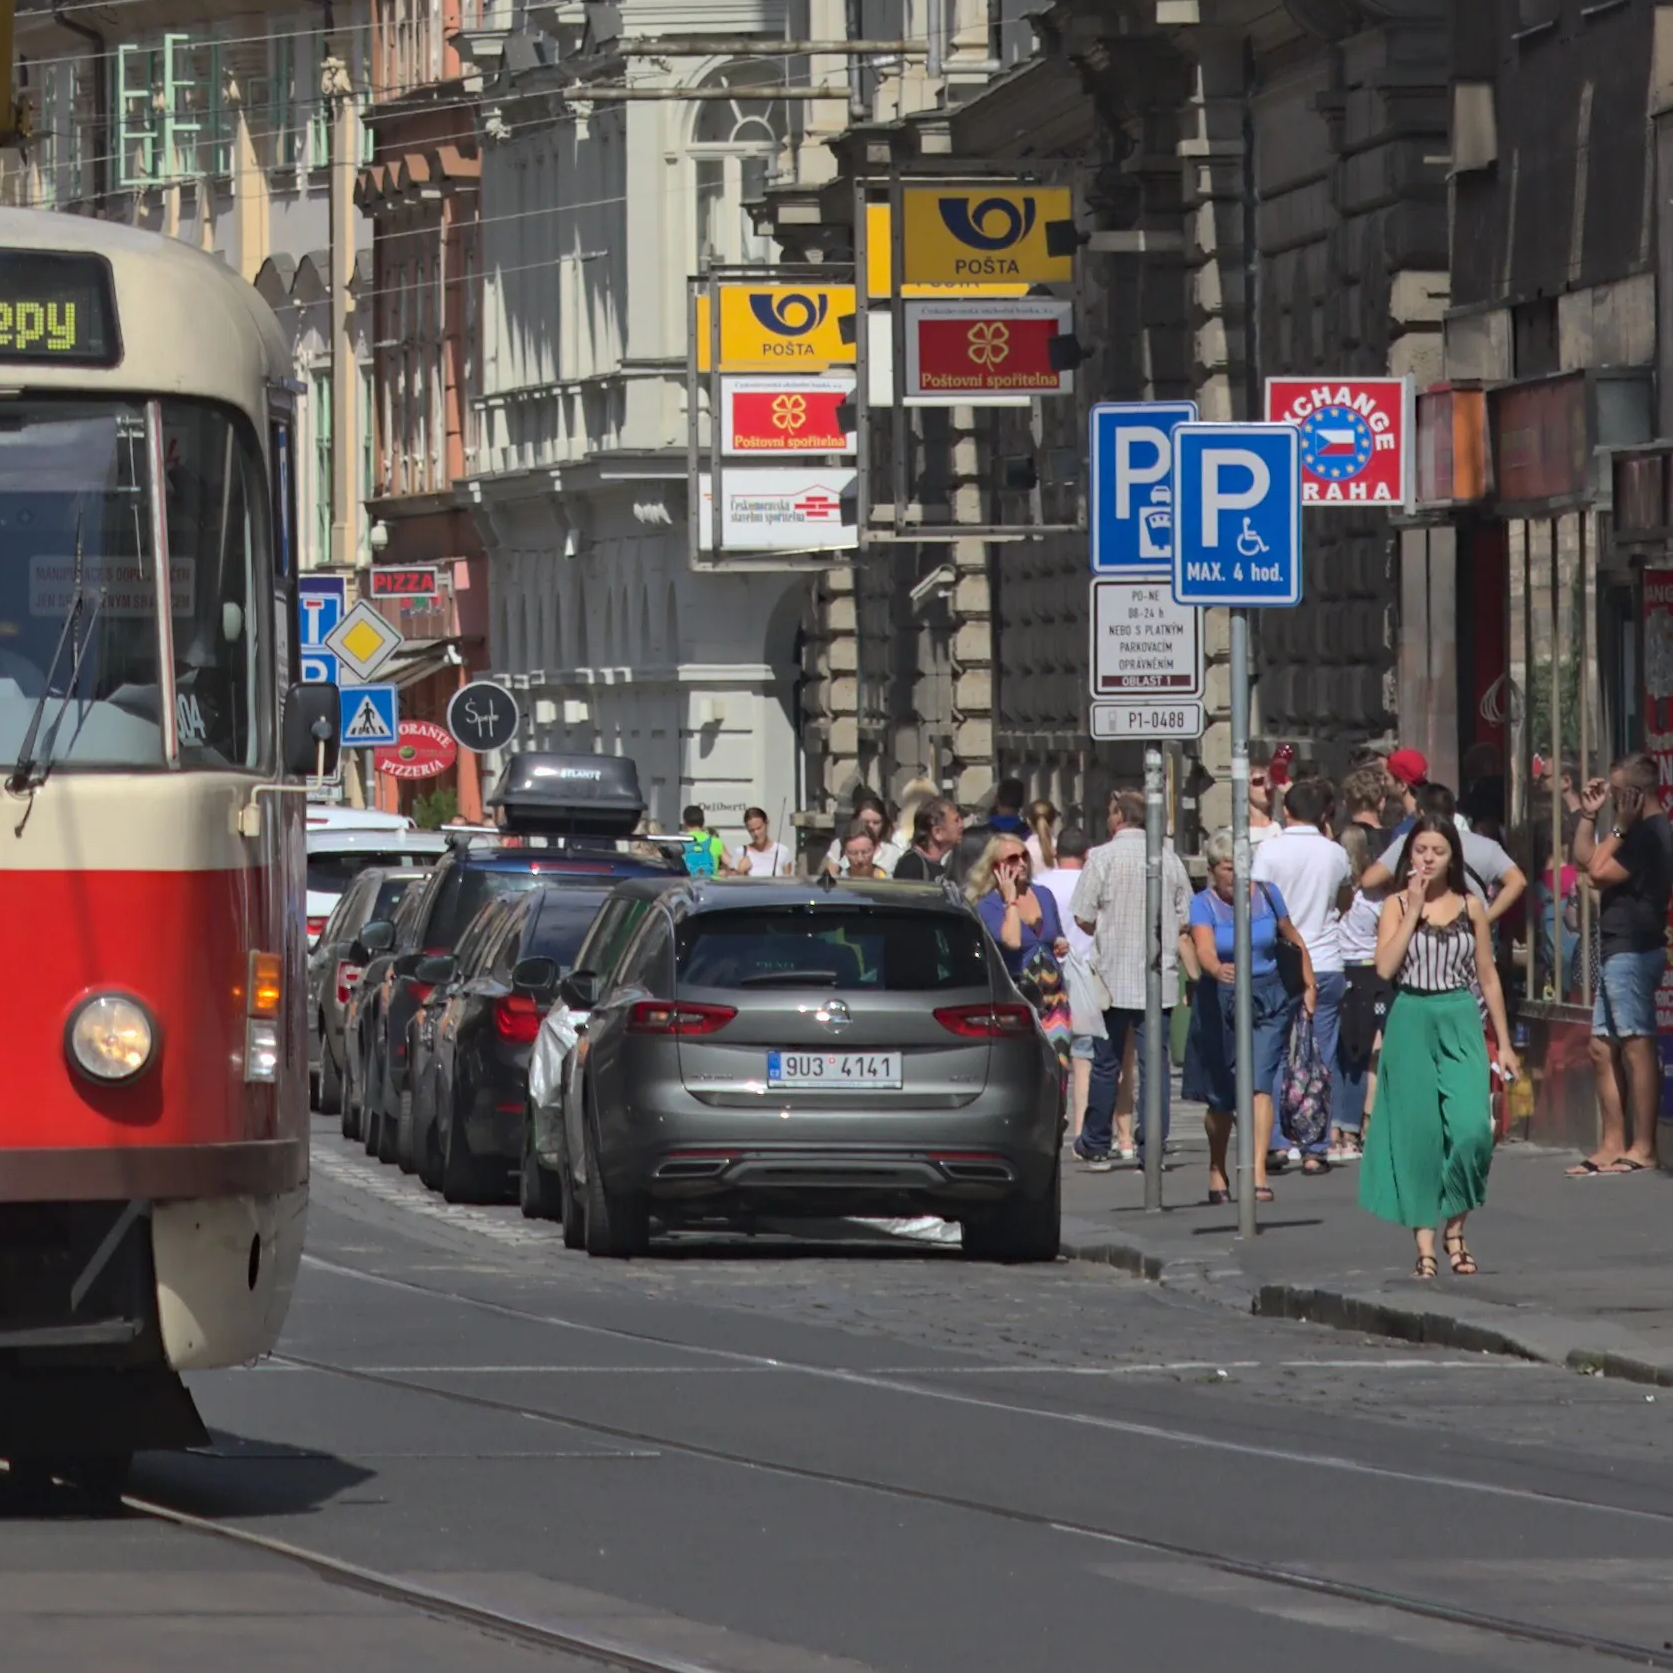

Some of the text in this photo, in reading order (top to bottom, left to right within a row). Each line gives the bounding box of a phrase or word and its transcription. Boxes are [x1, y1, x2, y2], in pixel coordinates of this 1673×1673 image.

[955, 256, 1019, 275] POŠTA
[762, 341, 814, 356] POŠTA
[922, 372, 1057, 390] Poštovní spořitelna
[734, 434, 845, 450] Poštovní spořitelna
[1115, 426, 1172, 519] P
[1201, 449, 1271, 547] P
[1302, 482, 1391, 500] RAHA
[1187, 562, 1284, 582] MAX. 4 hod.
[373, 573, 435, 592] PIZZA
[1131, 590, 1159, 601] PO-NE
[1128, 607, 1165, 619] 08-24 h
[1109, 622, 1184, 636] NEBO S PLATNÝM
[1120, 640, 1173, 652] PARKOVACÍM
[1118, 657, 1174, 670] OPRÁVNĚNÍM
[1122, 675, 1171, 686] OBLAST 1
[1129, 711, 1184, 730] P1-0488
[397, 721, 452, 749] ORANTE
[381, 759, 444, 777] PIZZERIA
[786, 1056, 890, 1077] 9U3 4141
